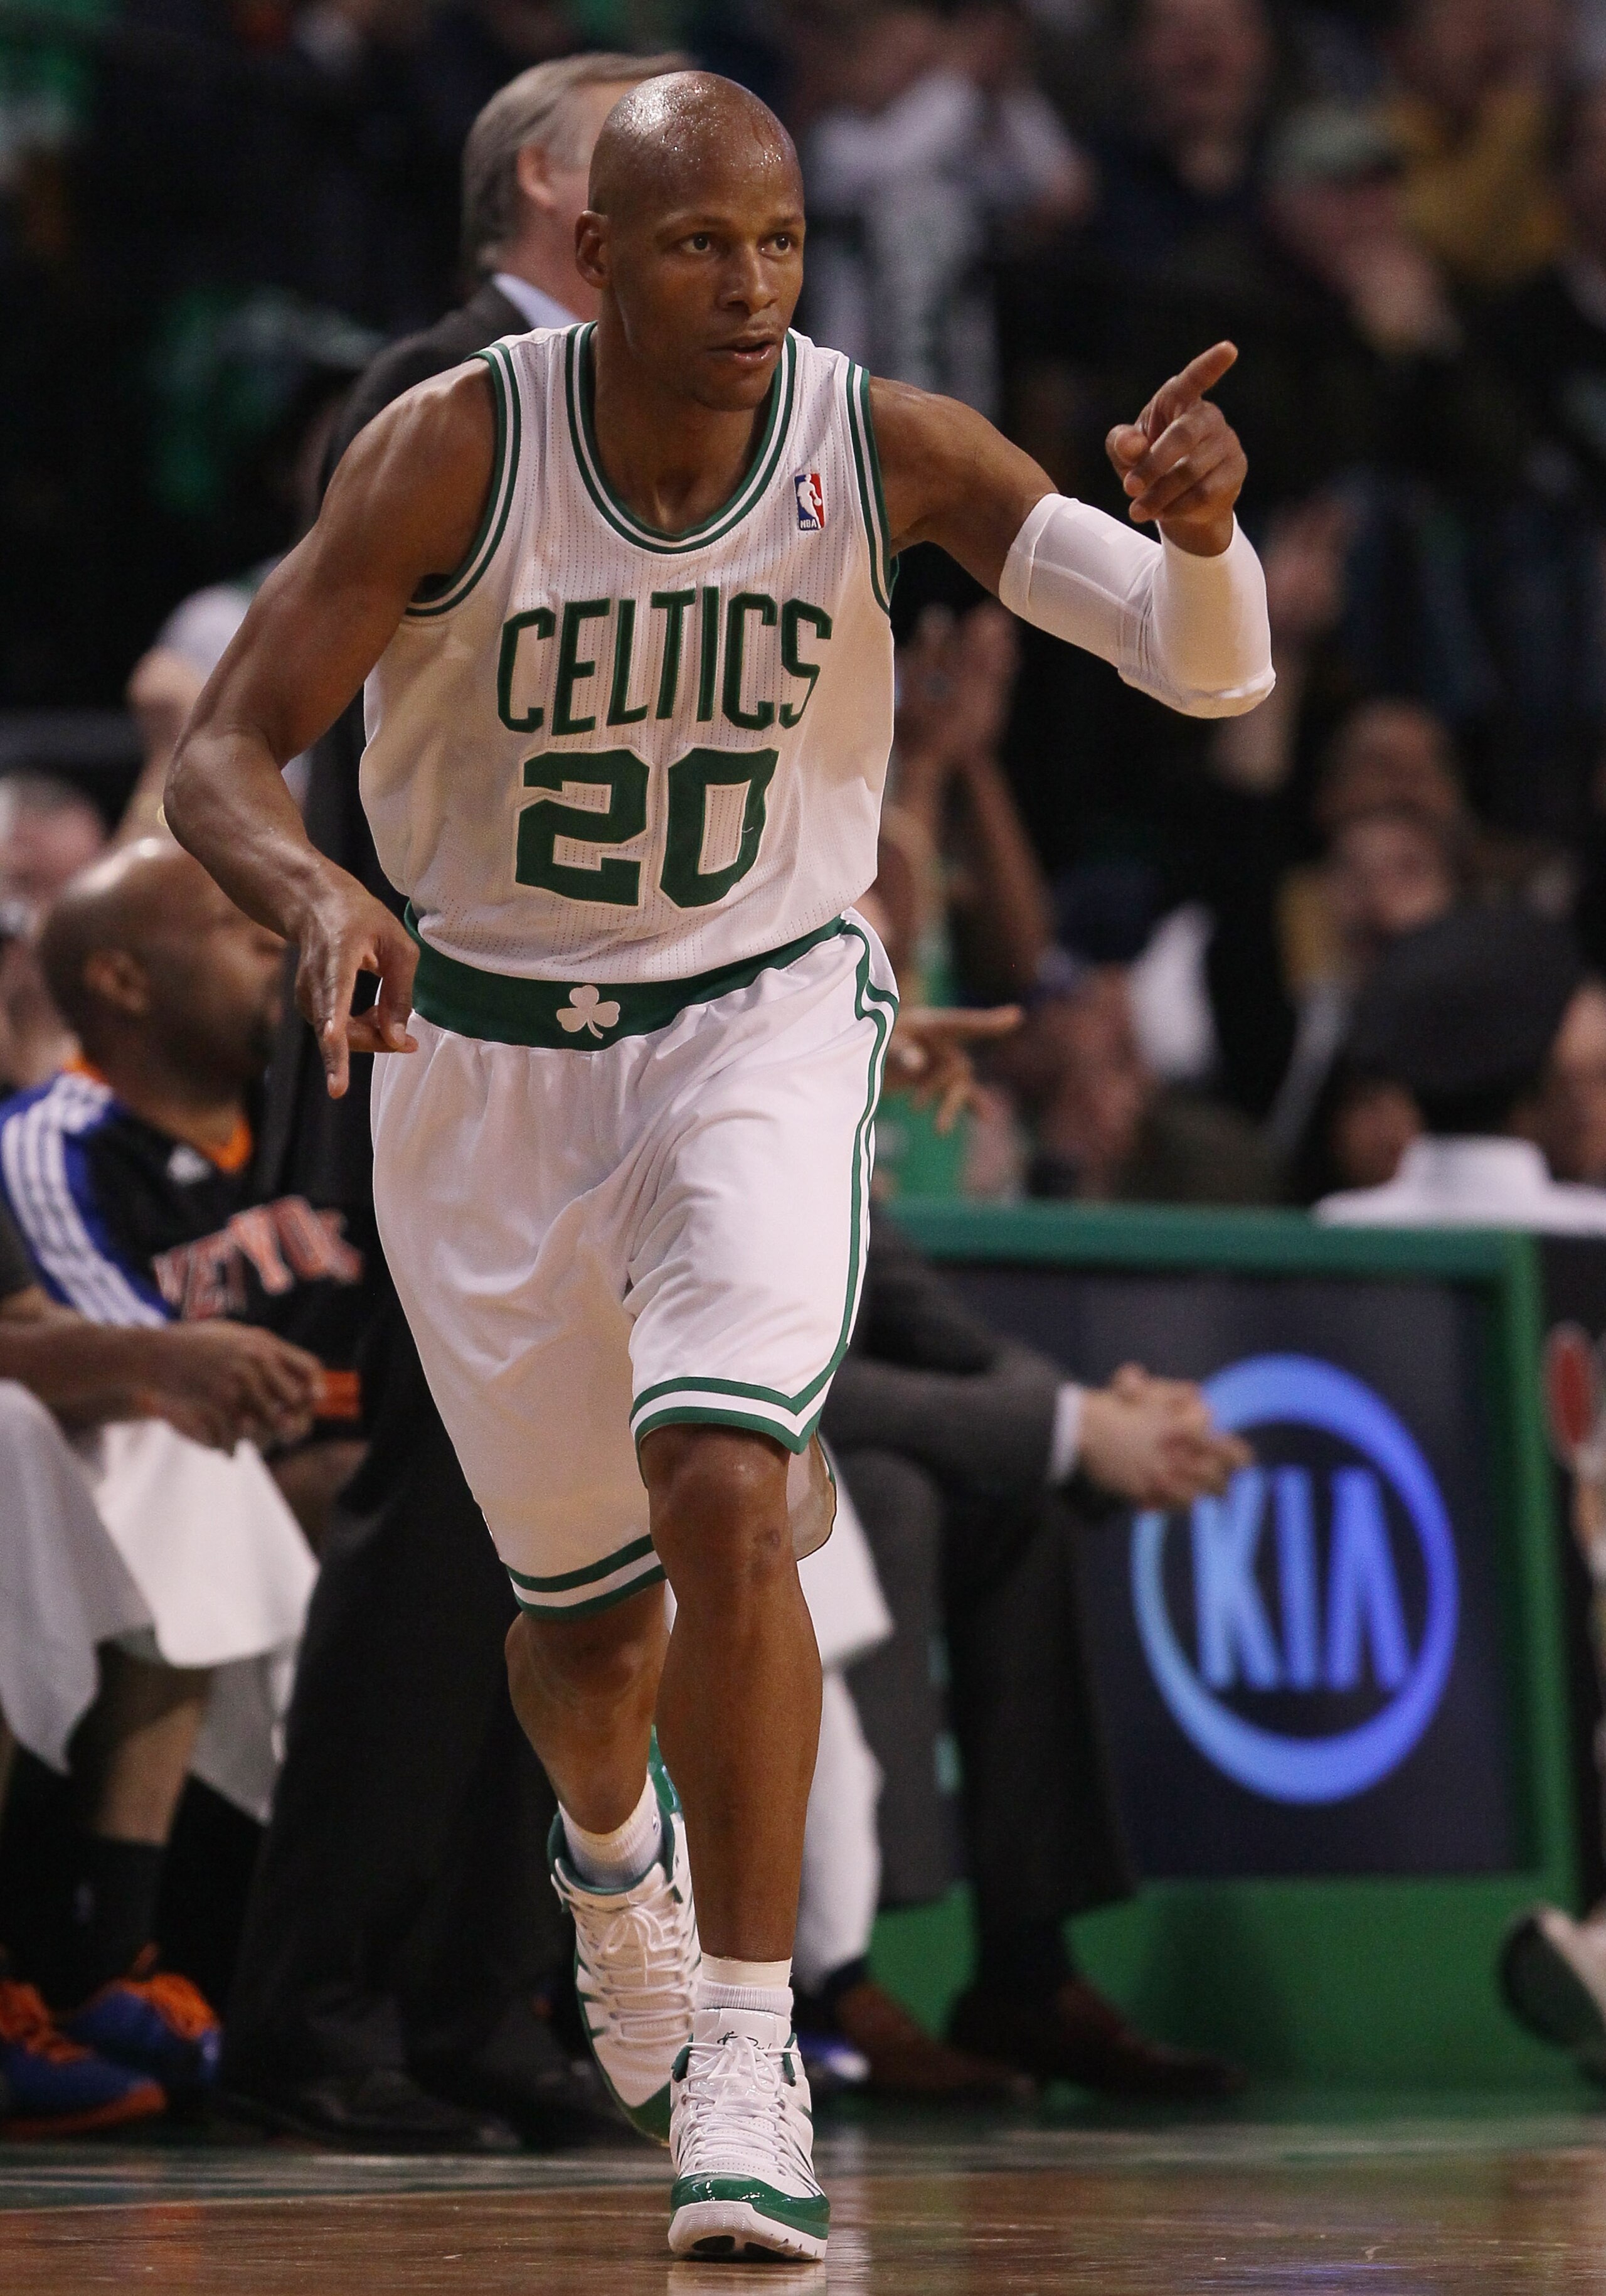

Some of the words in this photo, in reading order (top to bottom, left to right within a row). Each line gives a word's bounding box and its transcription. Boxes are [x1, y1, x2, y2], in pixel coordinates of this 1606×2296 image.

[800, 518, 817, 529] NBA
[497, 587, 832, 735] CELTICS
[515, 747, 779, 908] 20
[1193, 1465, 1413, 1689] KIA
